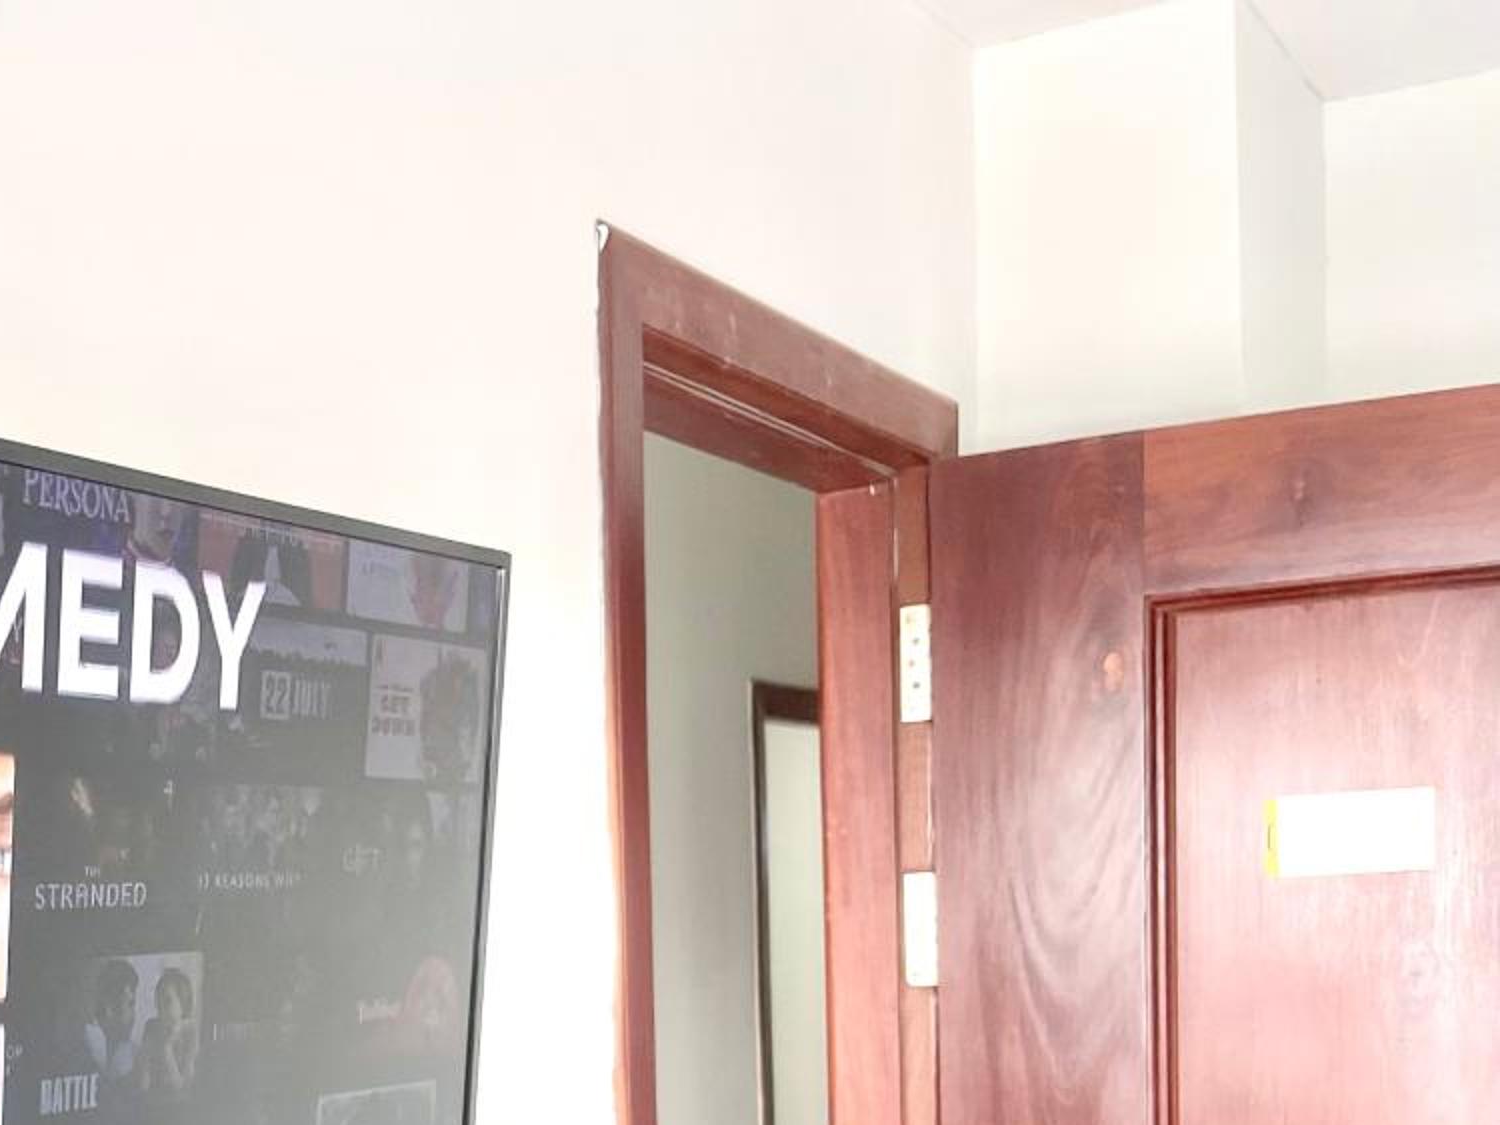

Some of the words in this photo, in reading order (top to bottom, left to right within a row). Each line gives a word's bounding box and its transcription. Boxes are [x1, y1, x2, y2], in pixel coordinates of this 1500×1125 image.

[21, 468, 132, 524] PERSONA
[34, 881, 148, 911] STRANDED
[38, 1073, 100, 1117] BATTLE
